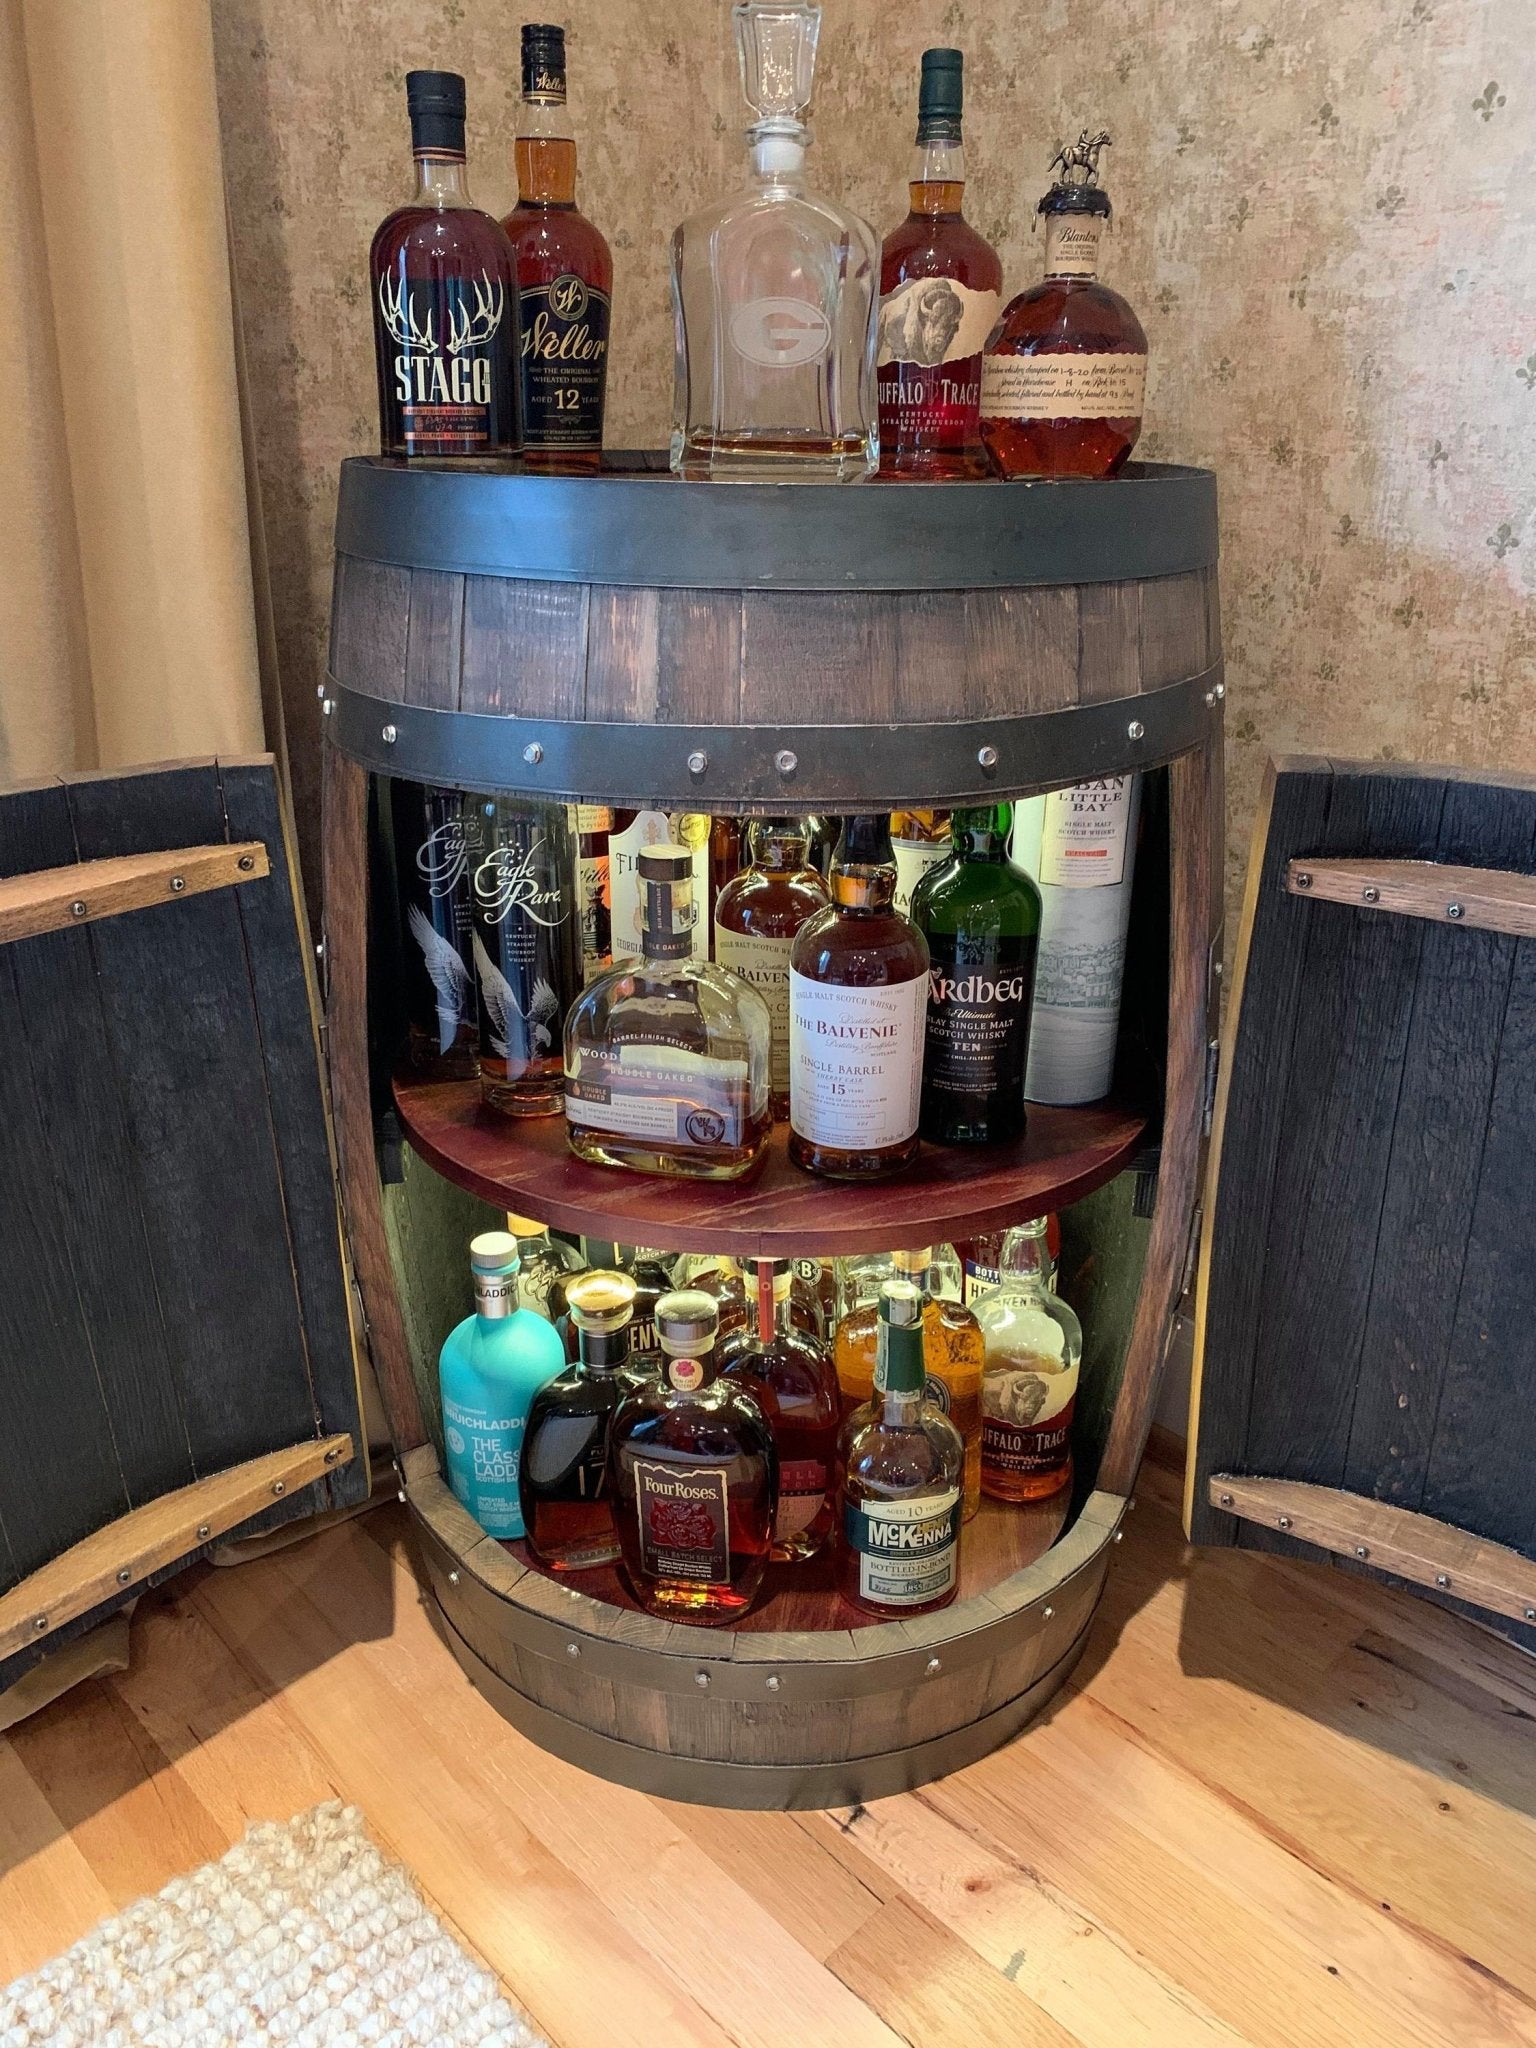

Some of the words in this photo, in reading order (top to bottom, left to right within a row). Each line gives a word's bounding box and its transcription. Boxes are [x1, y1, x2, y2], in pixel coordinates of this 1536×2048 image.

[520, 311, 607, 361] Weller
[395, 355, 492, 404] STAGG
[531, 396, 553, 404] AGED
[554, 388, 580, 410] 12
[879, 381, 924, 406] UFFALO
[941, 378, 979, 407] TRACE
[1073, 777, 1125, 791] BAN
[1059, 792, 1122, 803] LITTLE
[1072, 803, 1108, 812] BAY
[473, 837, 547, 908] Eagle
[752, 942, 779, 953] SCOTCH
[736, 965, 790, 984] BALVEN
[814, 991, 834, 1001] MALT
[835, 994, 868, 1006] SCOTCH
[869, 999, 898, 1013] WHISKY
[794, 1013, 814, 1032] THE
[816, 1018, 899, 1040] BALVENIE
[927, 1015, 947, 1027] SLAY
[949, 1020, 986, 1031] SINGLE
[989, 1018, 1014, 1030] MALT
[929, 1026, 964, 1040] SCOTCH
[967, 1029, 1008, 1040] WHISKY
[612, 1033, 639, 1044] BARREL
[640, 1033, 665, 1041] FINISH
[666, 1037, 694, 1051] SELECT
[952, 1041, 981, 1052] TEN
[578, 1046, 618, 1061] WOOD
[800, 1054, 834, 1073] SINGLE
[838, 1064, 885, 1076] BARREL
[610, 1066, 652, 1079] DOUBLE
[657, 1072, 693, 1083] OAKED
[582, 1085, 607, 1096] DOUBLE
[584, 1092, 606, 1101] OAKED
[831, 1083, 846, 1096] 15
[471, 1436, 502, 1452] THE
[1036, 1426, 1067, 1452] TRACE
[643, 1476, 677, 1495] Four
[908, 1505, 923, 1518] 10
[671, 1550, 695, 1561] BATCH
[696, 1555, 723, 1563] SELECT
